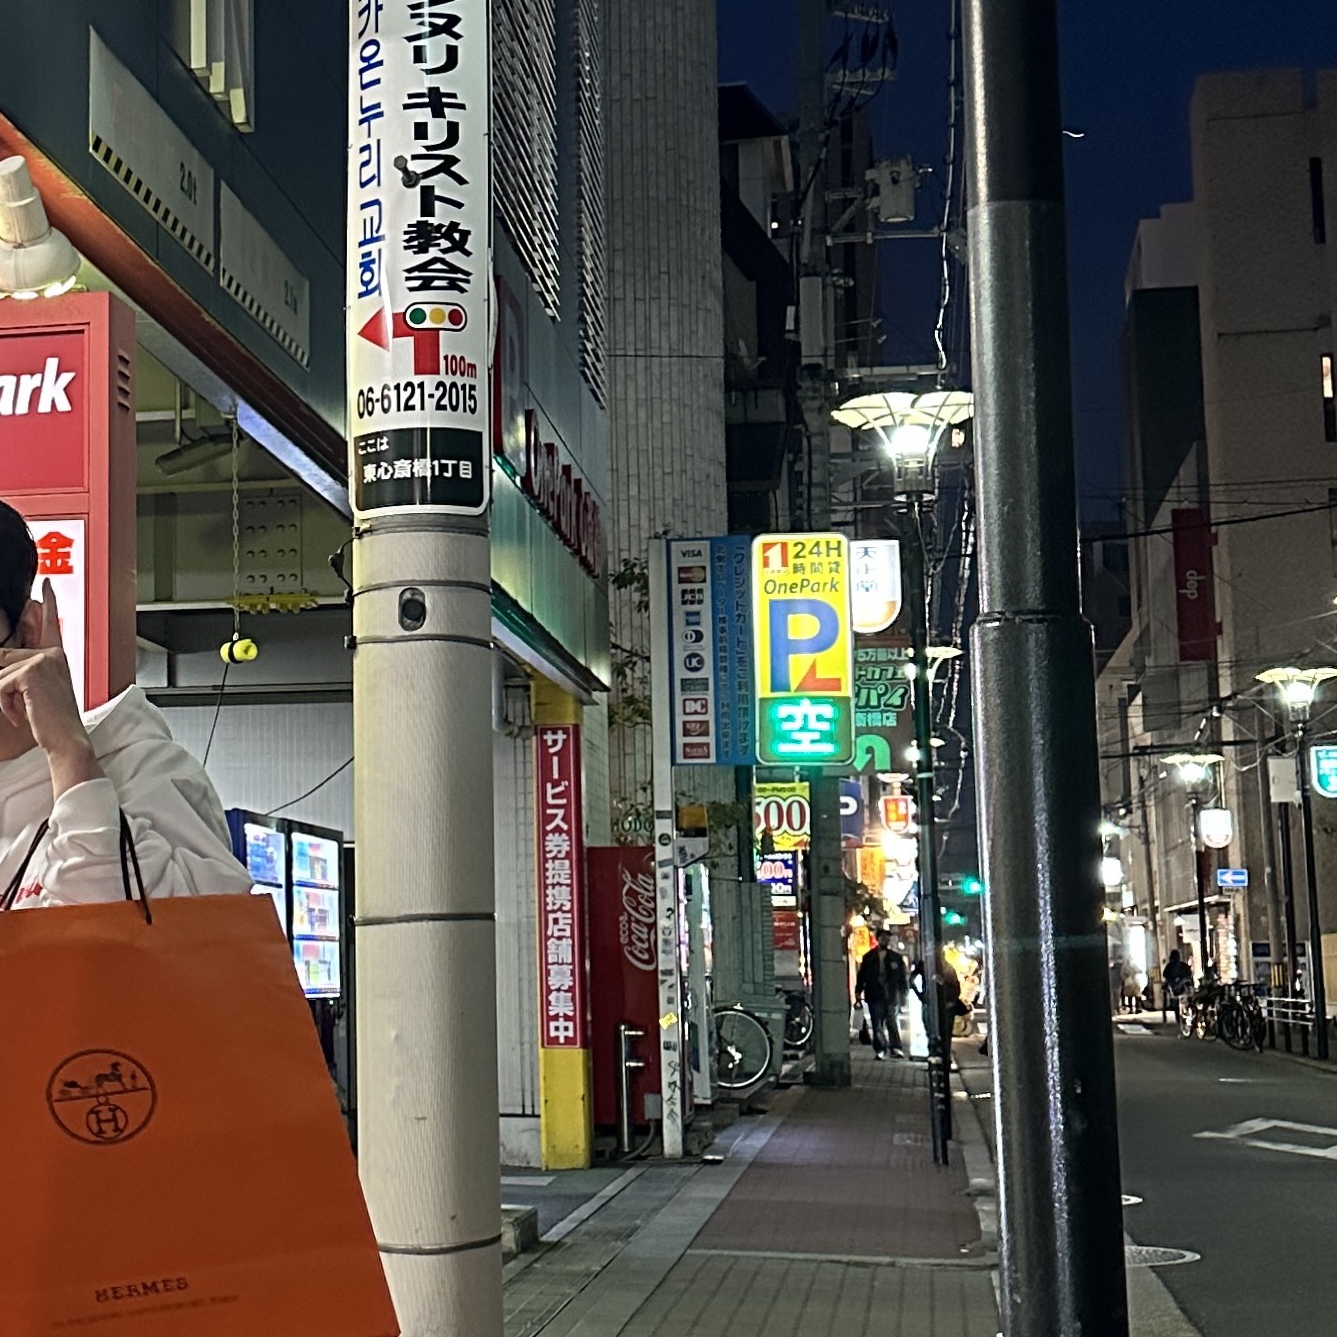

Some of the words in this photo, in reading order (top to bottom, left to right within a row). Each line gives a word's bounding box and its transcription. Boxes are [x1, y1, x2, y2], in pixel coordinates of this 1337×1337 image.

[401, 0, 474, 294] ヌリキリスト教会
[443, 354, 477, 379] 100m
[357, 380, 478, 419] 06-6121-2015
[358, 436, 390, 455] ここは
[680, 549, 703, 558] VISA
[792, 540, 842, 560] 24H
[763, 577, 840, 595] OnePark
[769, 598, 840, 692] P
[776, 697, 836, 754] 空
[542, 730, 577, 1045] サービス券提携店舗募集中
